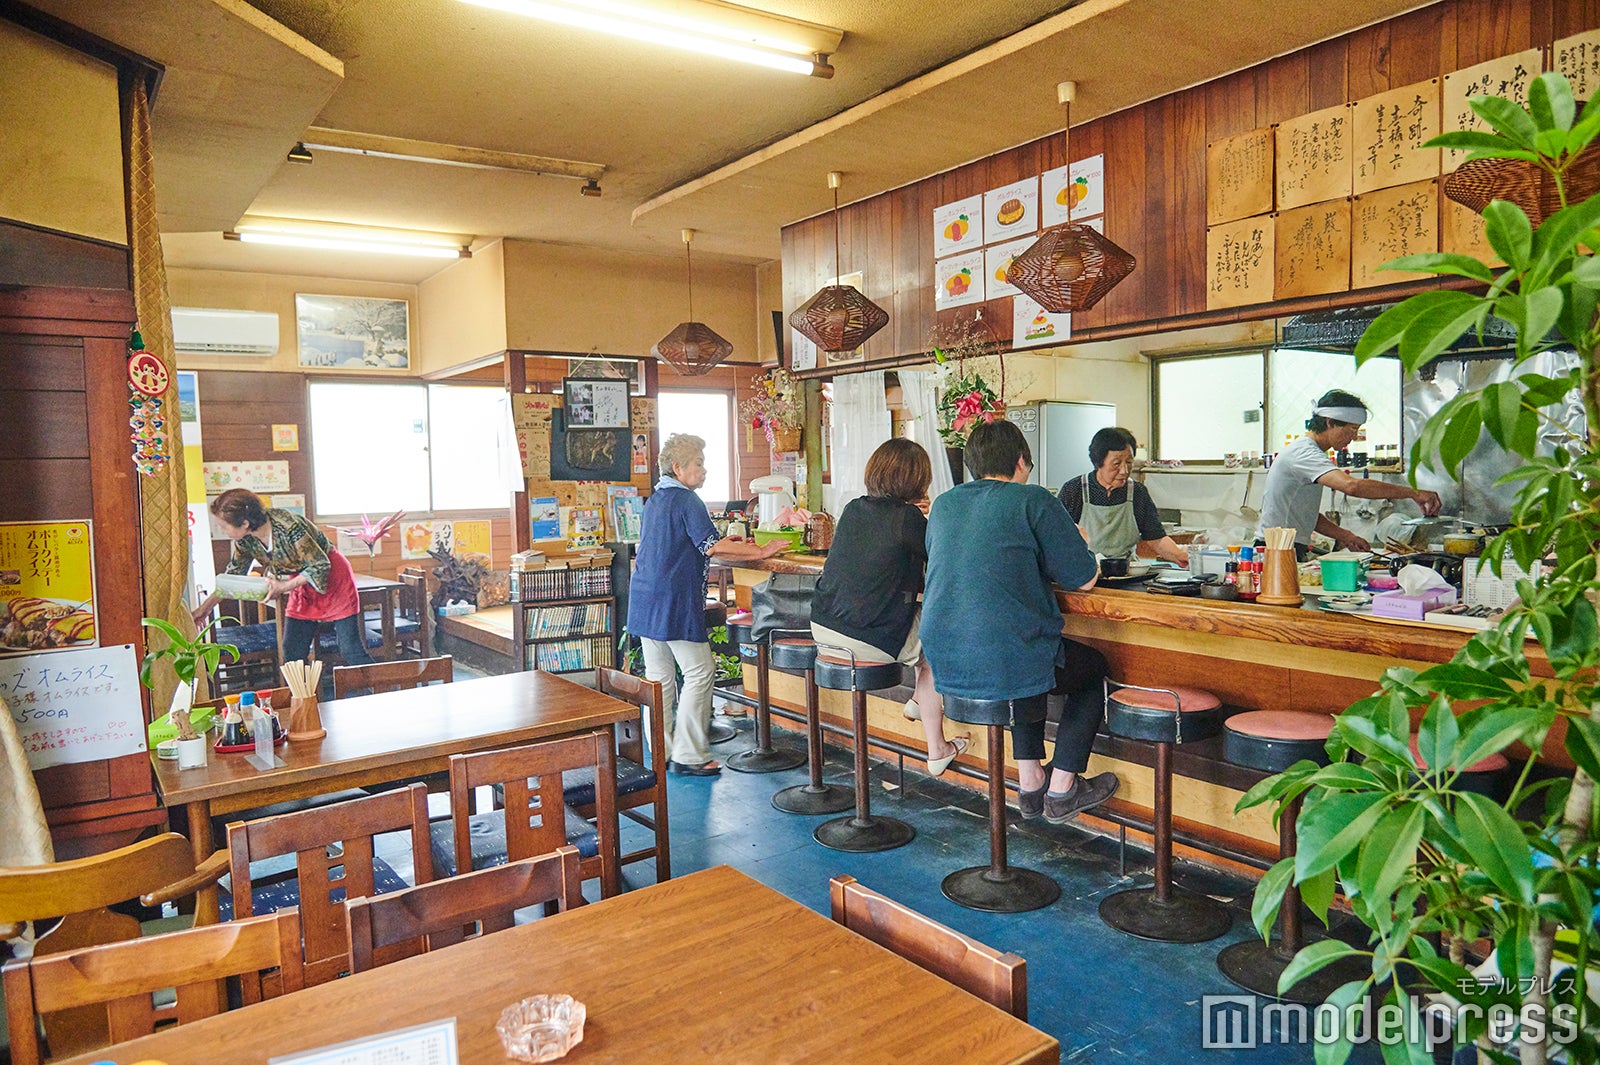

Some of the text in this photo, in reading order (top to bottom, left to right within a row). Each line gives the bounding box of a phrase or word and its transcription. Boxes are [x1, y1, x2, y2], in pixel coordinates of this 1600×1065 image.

[26, 530, 41, 578] オムライス
[38, 663, 115, 688] オムライス
[16, 708, 69, 724] 500円
